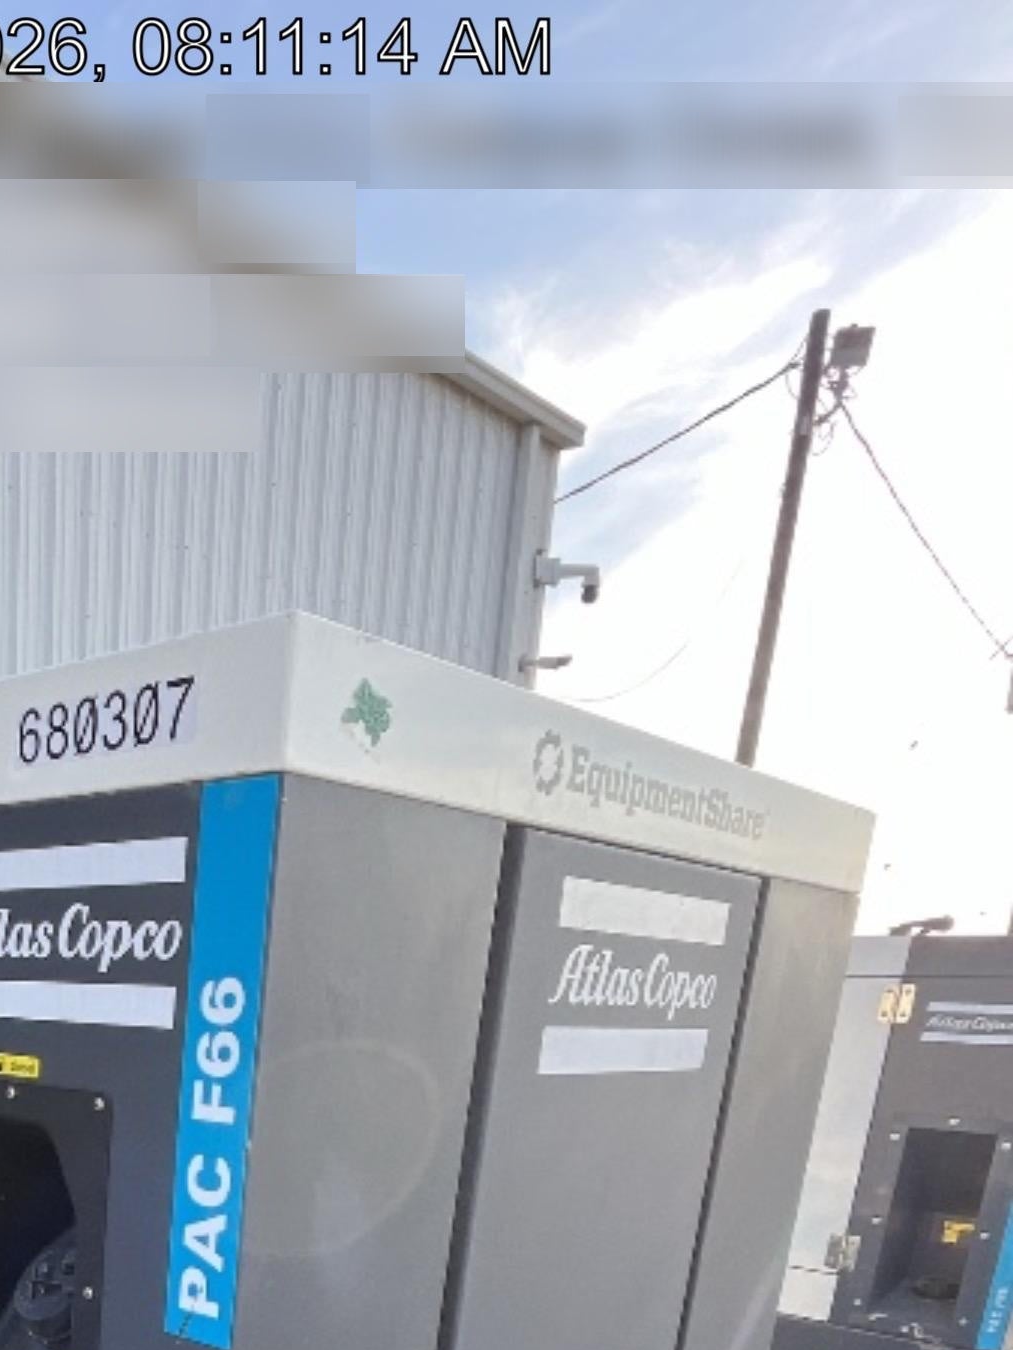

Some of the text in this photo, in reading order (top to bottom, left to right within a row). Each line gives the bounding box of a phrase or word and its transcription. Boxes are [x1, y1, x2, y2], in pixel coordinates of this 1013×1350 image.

[18, 676, 195, 765] 680307
[566, 743, 765, 839] EquipmentShare
[58, 893, 183, 973] Copco
[548, 944, 717, 1021] Atlas Copco
[177, 976, 246, 1320] PAC F66
